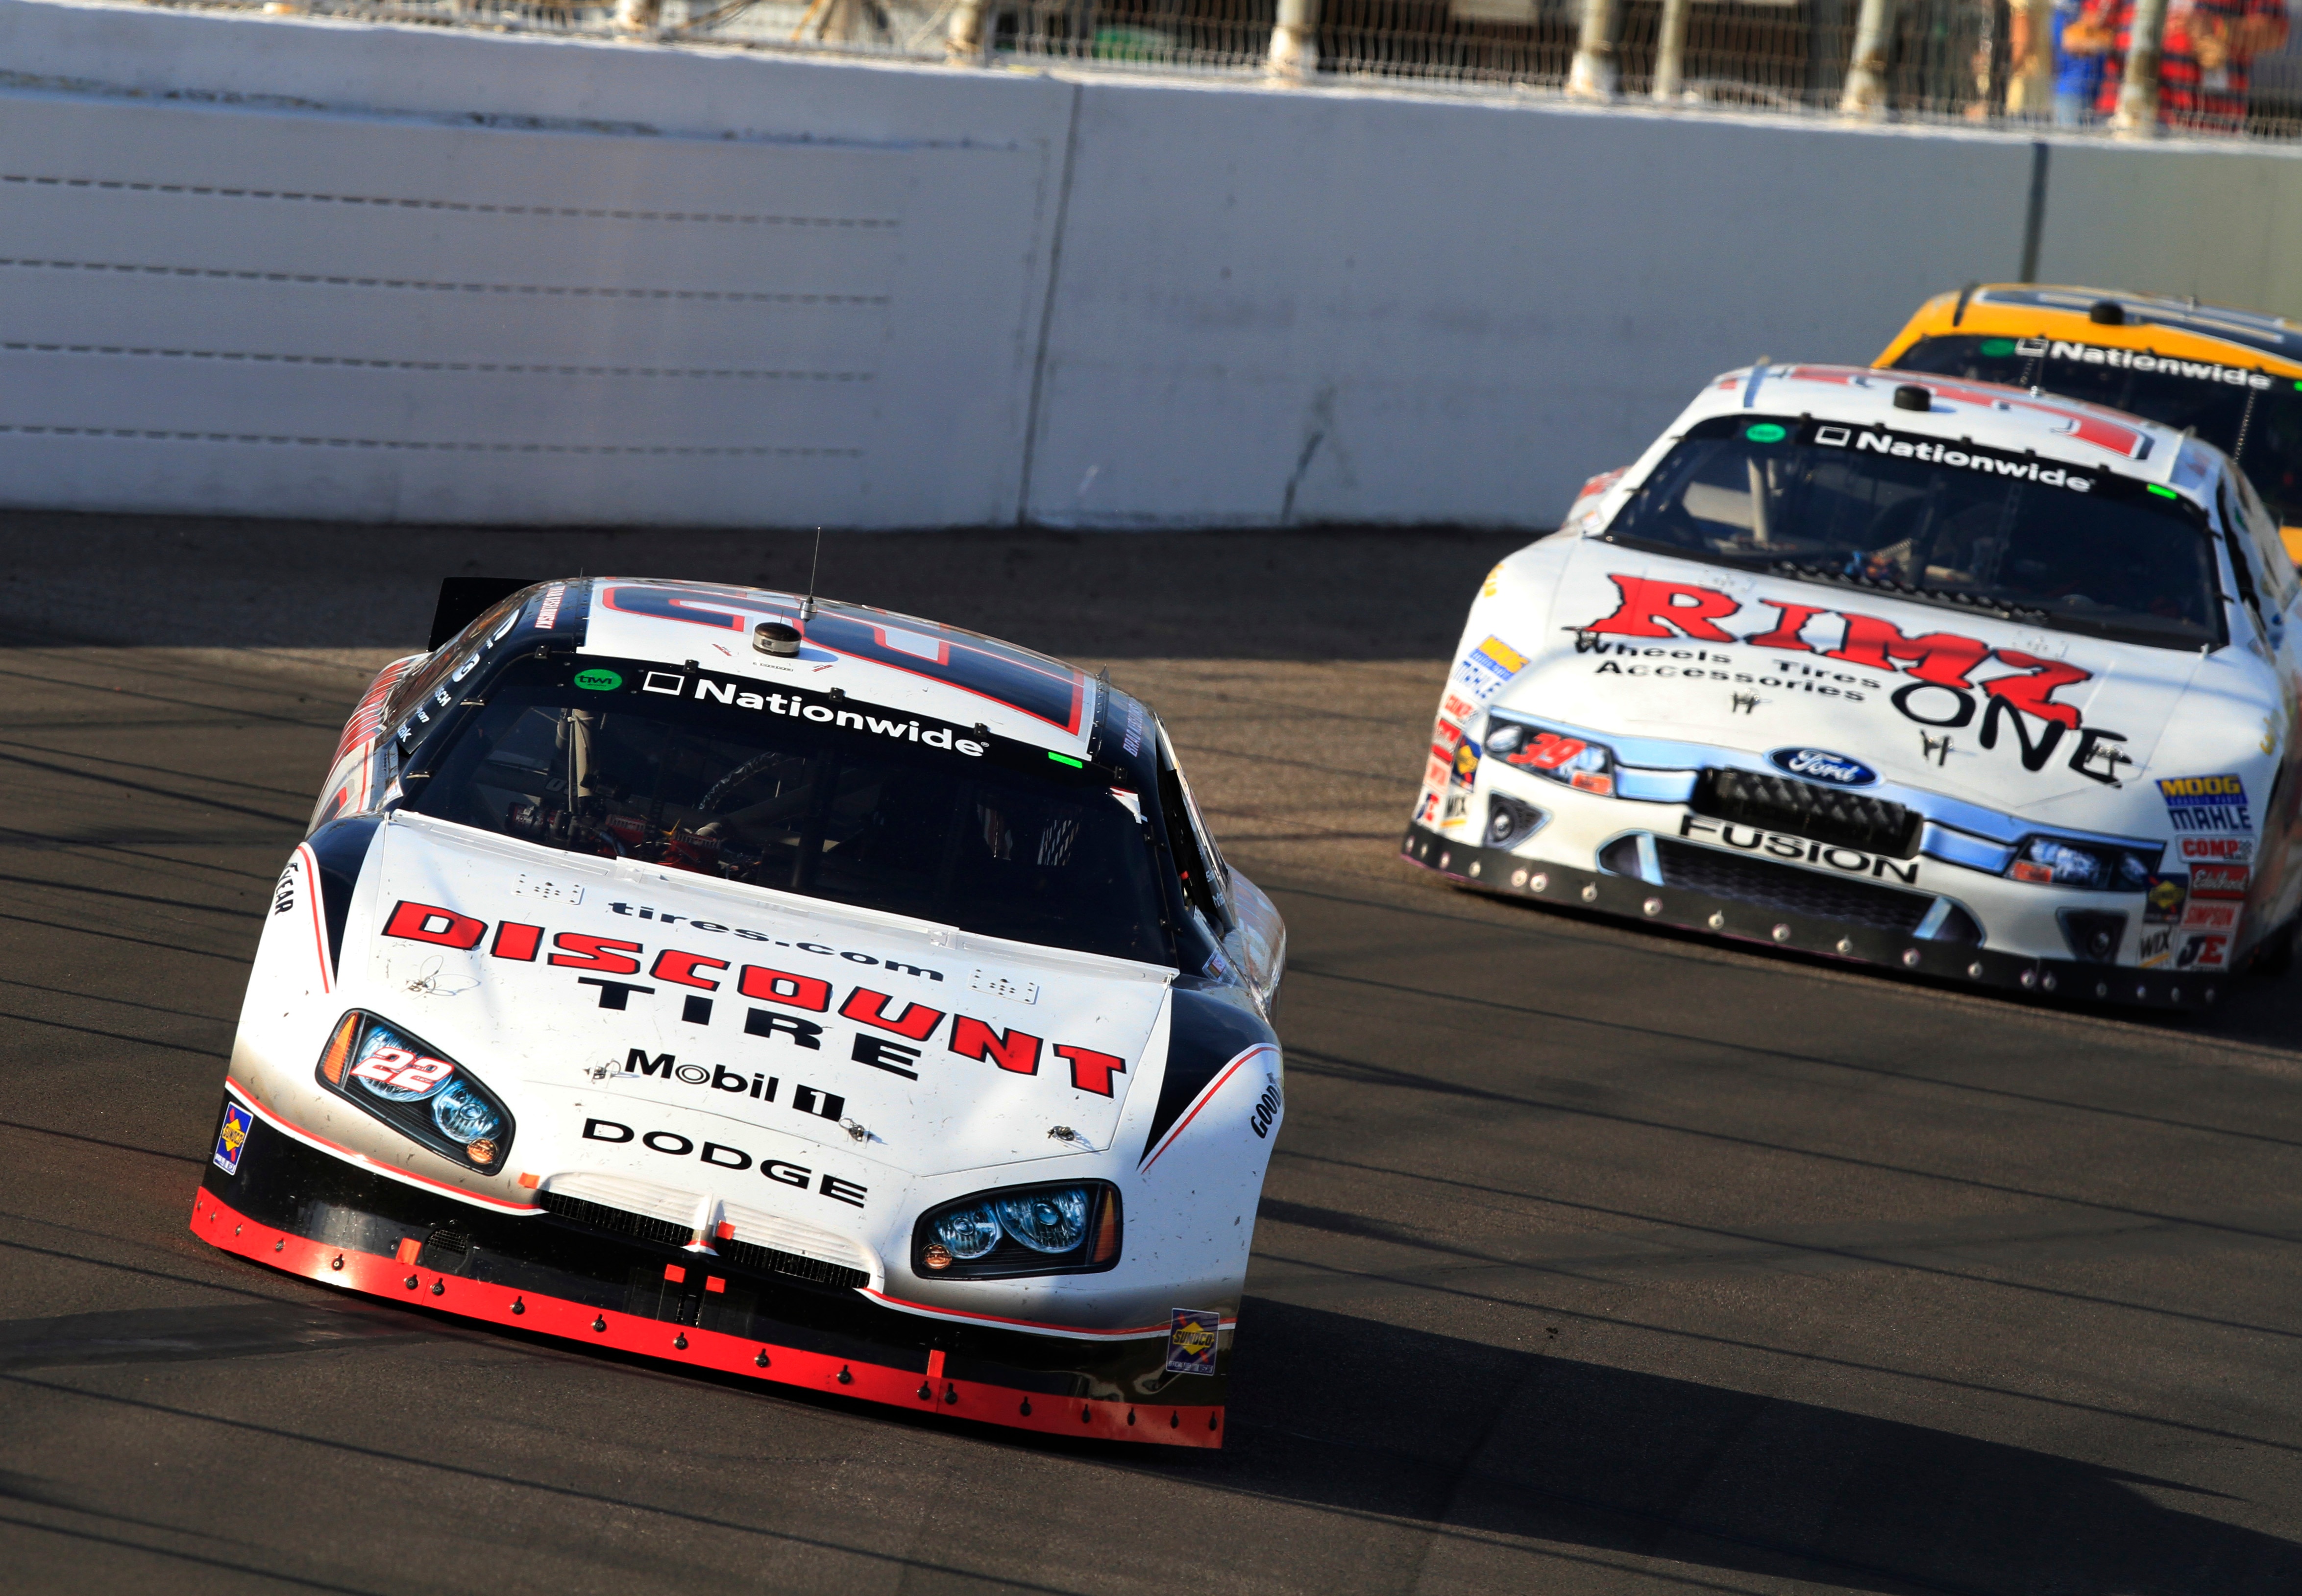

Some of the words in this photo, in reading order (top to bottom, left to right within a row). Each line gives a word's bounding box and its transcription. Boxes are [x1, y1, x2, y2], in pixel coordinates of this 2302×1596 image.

[2050, 342, 2272, 390] Nationwide
[1856, 432, 2091, 492] Nationwide
[1595, 660, 1866, 701] Accessories
[1774, 658, 1881, 688] Tires
[695, 678, 983, 757] Nationwide
[1891, 682, 2132, 788] ONE
[1123, 728, 1141, 757] BRAD
[1506, 732, 1587, 769] 39
[1789, 750, 1860, 782] Ford
[2160, 775, 2241, 797] MOOG
[2168, 806, 2253, 830] MAHLE
[1680, 814, 1918, 884] FUSION
[2182, 838, 2239, 856] COMP
[608, 902, 944, 982] tires.com
[2177, 934, 2228, 967] JE
[381, 900, 1127, 1098] DISCOUNT
[578, 976, 922, 1081] TIRE
[350, 1046, 454, 1093] 22
[624, 1048, 779, 1103] Mobil
[223, 1125, 244, 1146] SUNOCO
[582, 1118, 868, 1209] DODGE
[1174, 1330, 1213, 1347] SUNOCO
